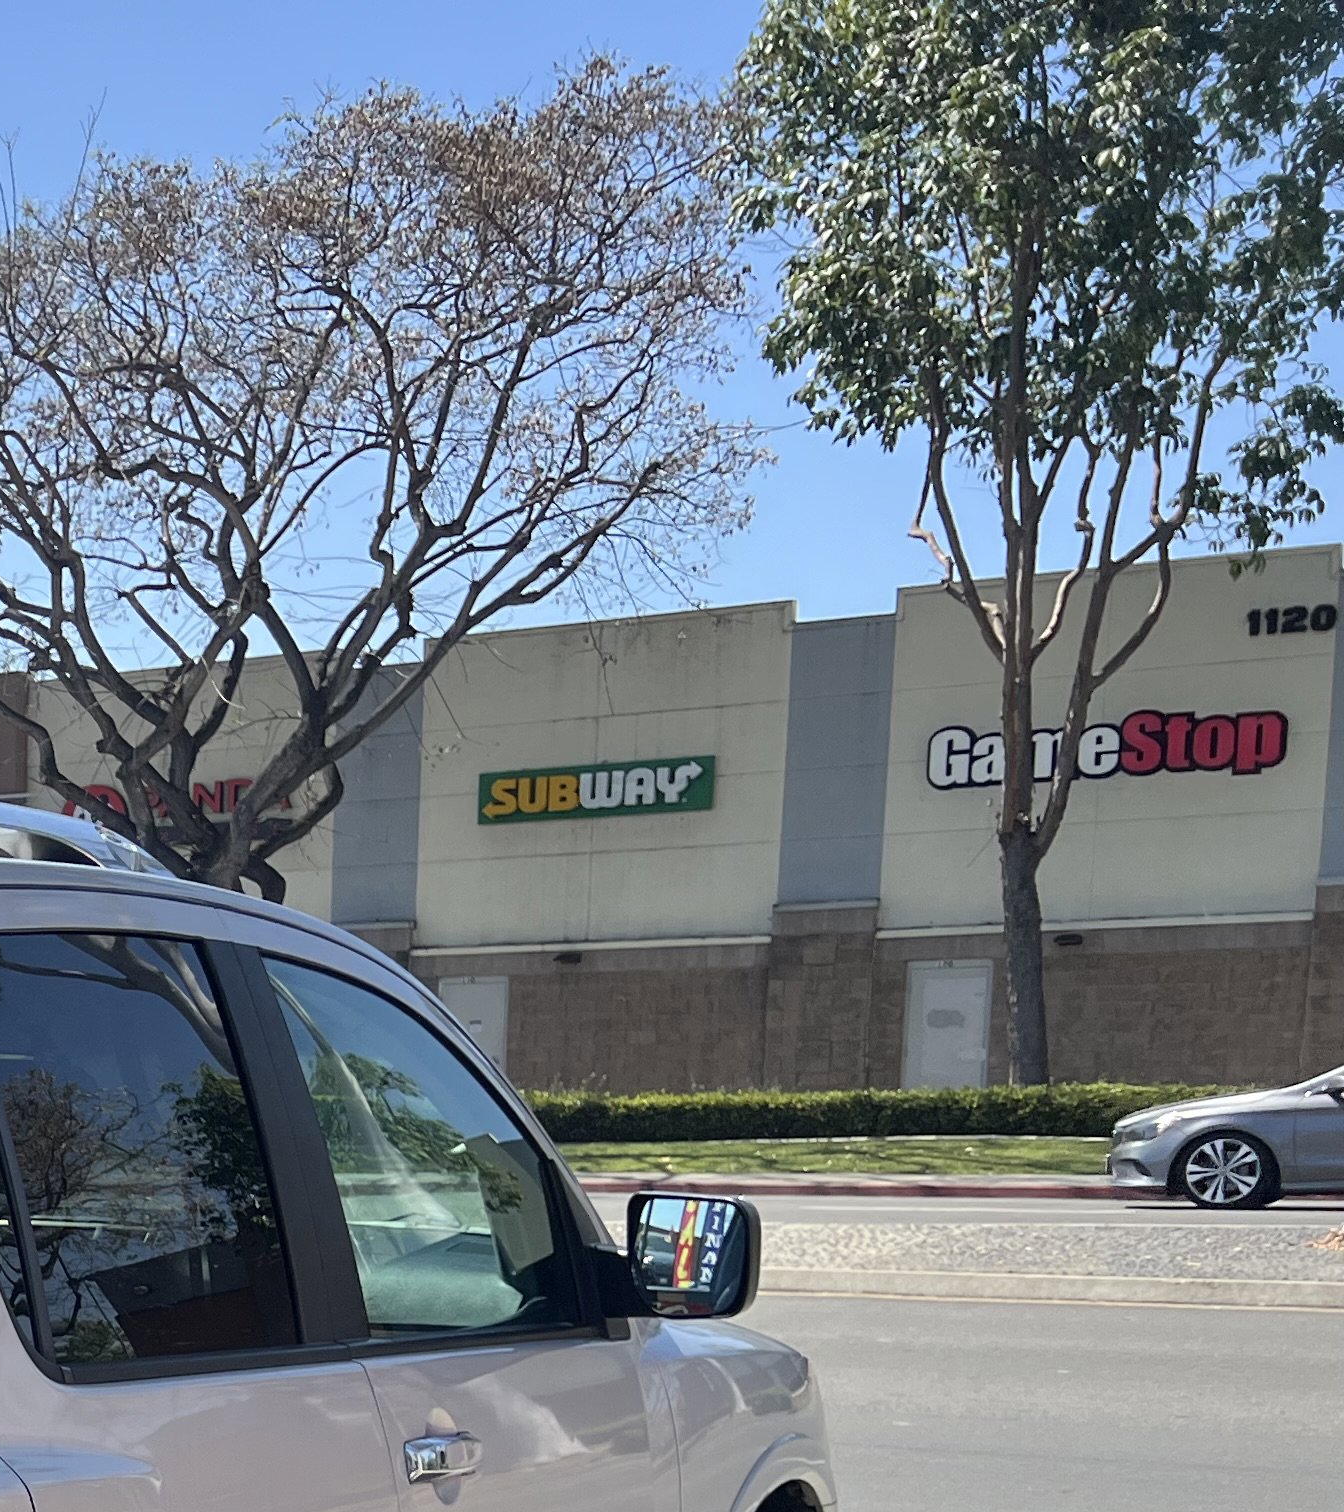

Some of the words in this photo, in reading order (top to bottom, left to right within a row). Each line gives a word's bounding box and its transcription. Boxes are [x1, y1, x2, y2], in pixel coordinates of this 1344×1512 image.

[1247, 604, 1337, 637] 1120
[926, 709, 1288, 789] GameStop
[481, 760, 704, 820] SUBWAY
